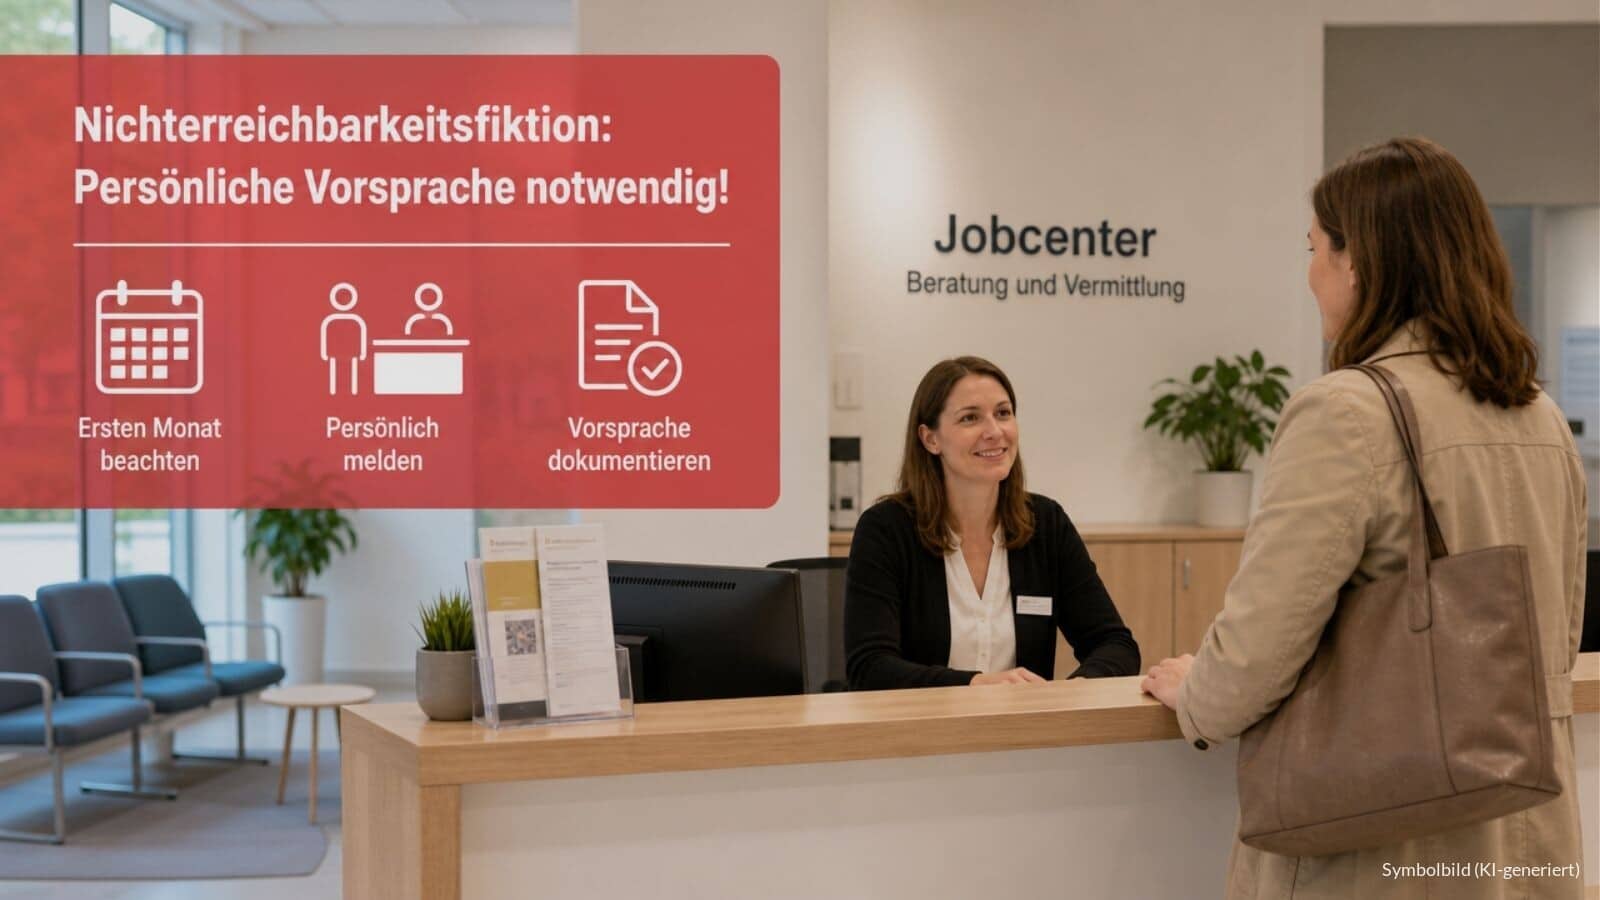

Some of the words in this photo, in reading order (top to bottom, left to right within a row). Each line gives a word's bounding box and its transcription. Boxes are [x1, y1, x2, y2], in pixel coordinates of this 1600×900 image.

[934, 214, 1158, 258] Jobcenter
[907, 270, 1008, 301] Beratung
[1016, 273, 1057, 296] und
[1063, 273, 1185, 304] Vermittlung
